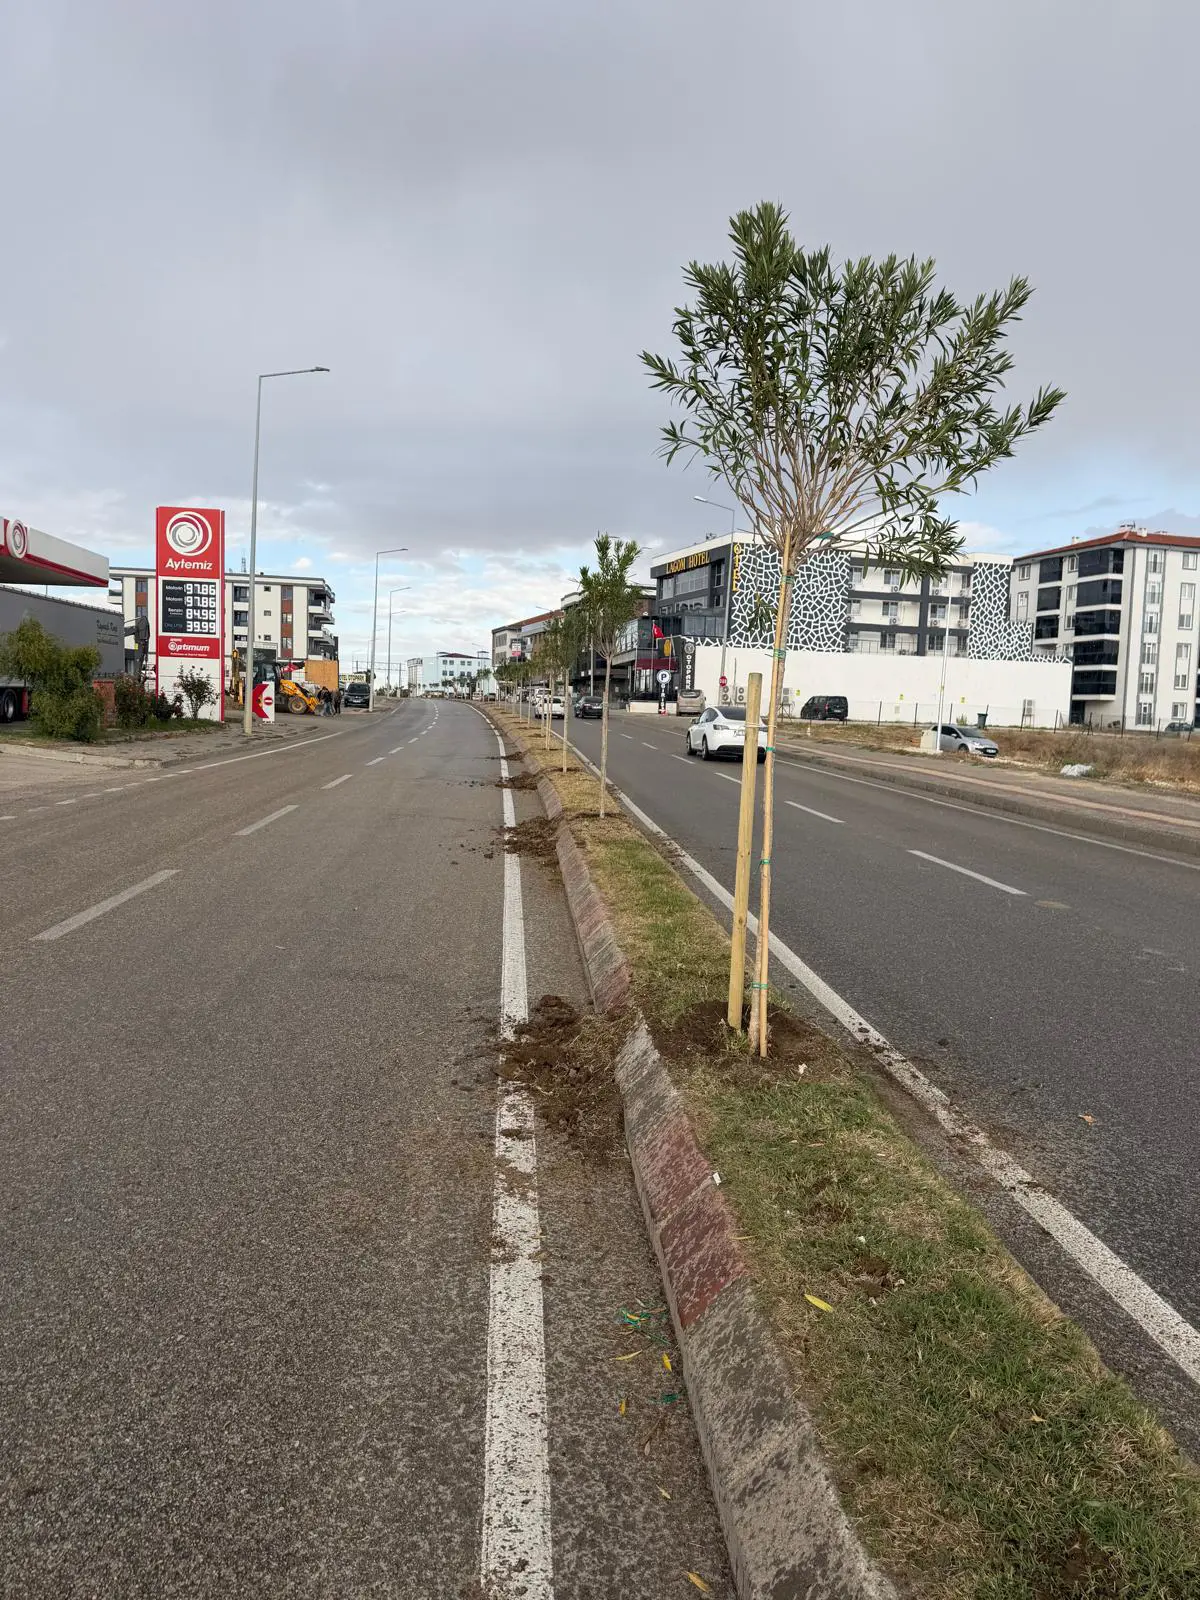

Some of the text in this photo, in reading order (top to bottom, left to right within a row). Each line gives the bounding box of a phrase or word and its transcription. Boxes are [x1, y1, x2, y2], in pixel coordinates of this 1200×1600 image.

[165, 558, 213, 571] Aytemiz
[688, 551, 710, 568] HOTEL
[660, 673, 667, 681] P
